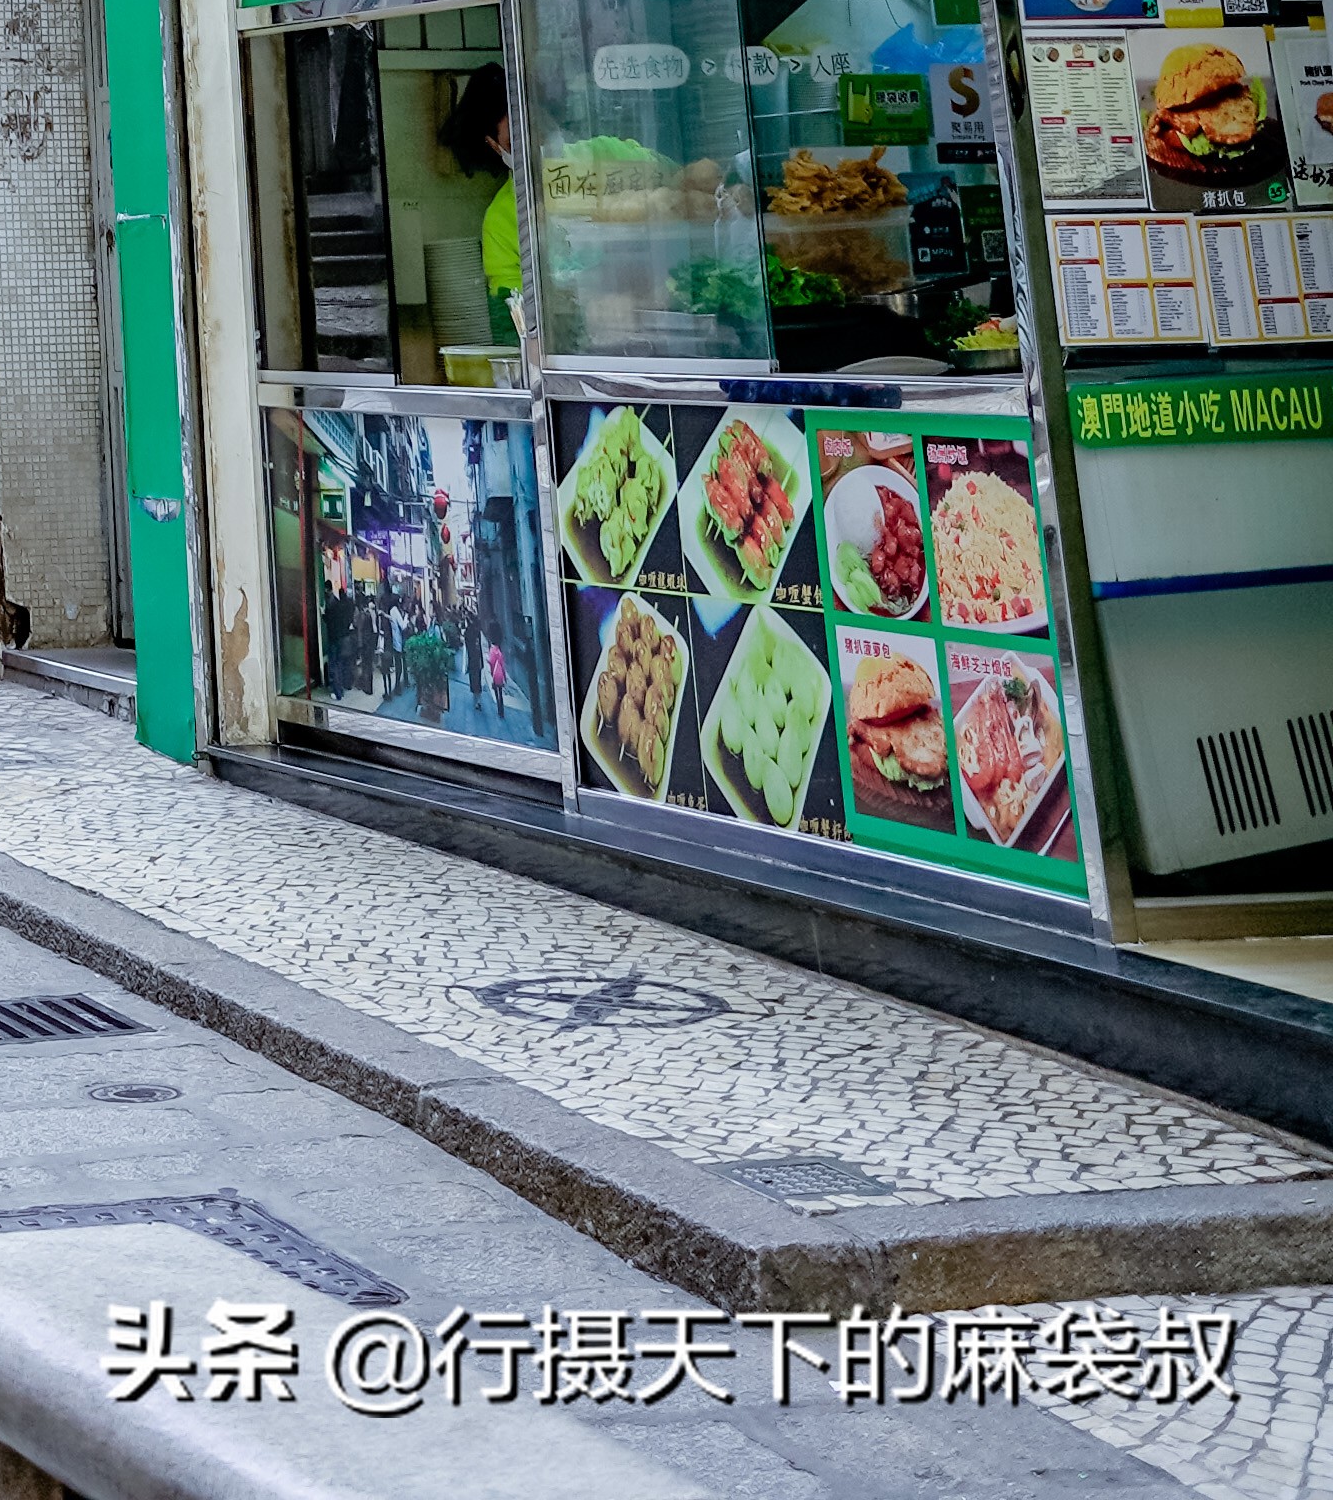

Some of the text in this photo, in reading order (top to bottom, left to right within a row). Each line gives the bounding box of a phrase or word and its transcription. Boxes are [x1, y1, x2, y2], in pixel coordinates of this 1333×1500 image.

[1202, 190, 1246, 208] 猪扒包
[1077, 386, 1322, 440] 澳門地道小吃 MACAU
